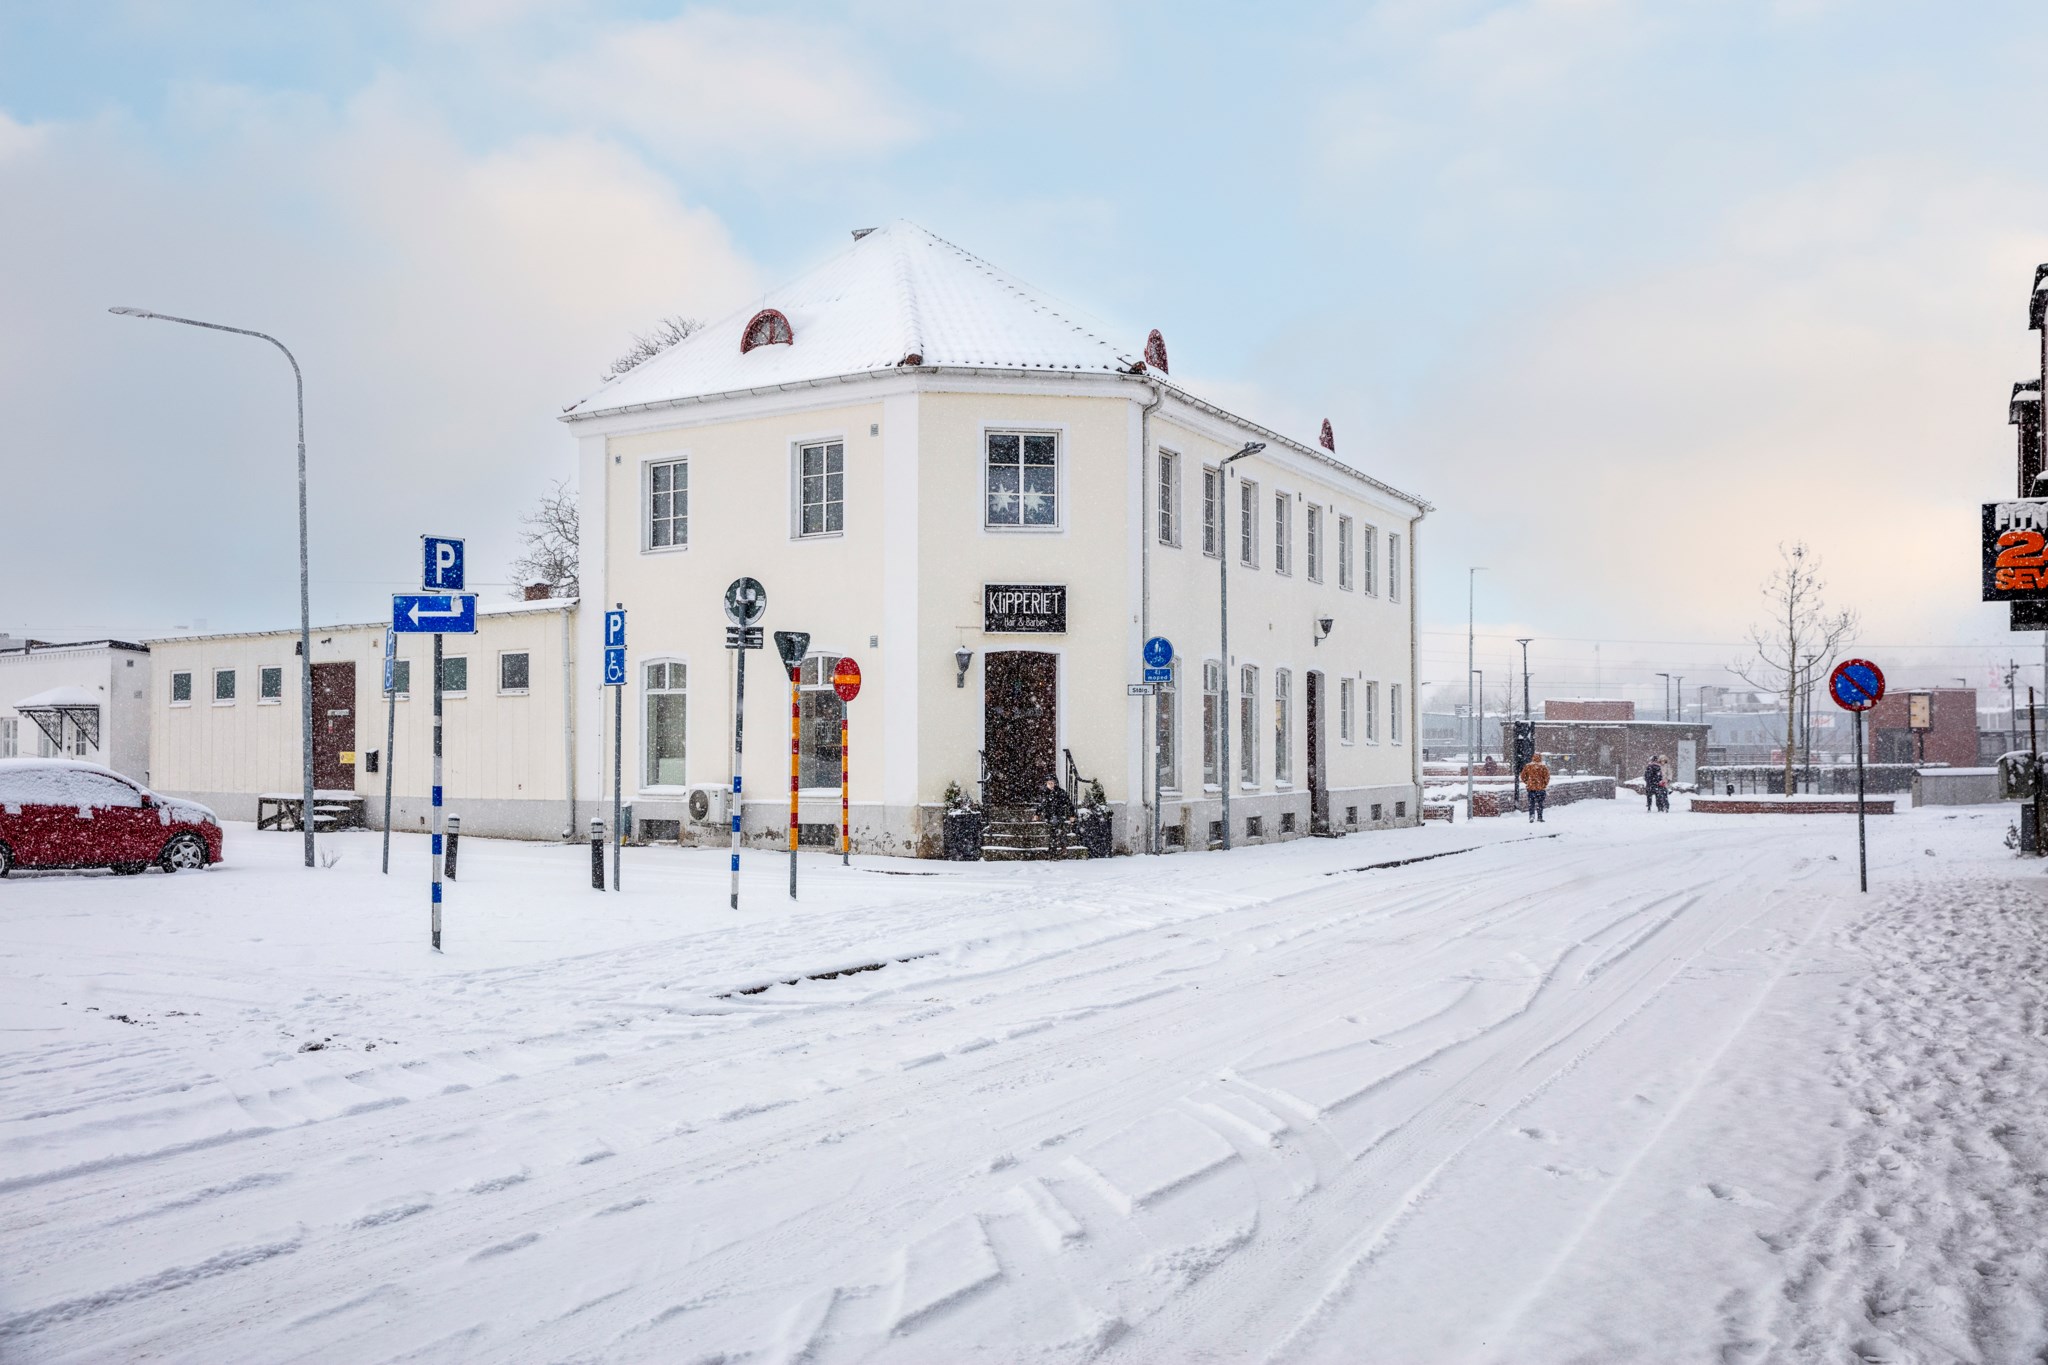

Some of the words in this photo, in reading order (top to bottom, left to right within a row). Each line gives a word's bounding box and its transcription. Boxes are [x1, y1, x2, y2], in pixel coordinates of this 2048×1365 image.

[436, 542, 456, 584] P
[1996, 530, 2048, 568] 2
[610, 614, 622, 644] P
[1004, 617, 1016, 627] Hair
[1017, 617, 1025, 627] &
[1025, 617, 1047, 627] Barber
